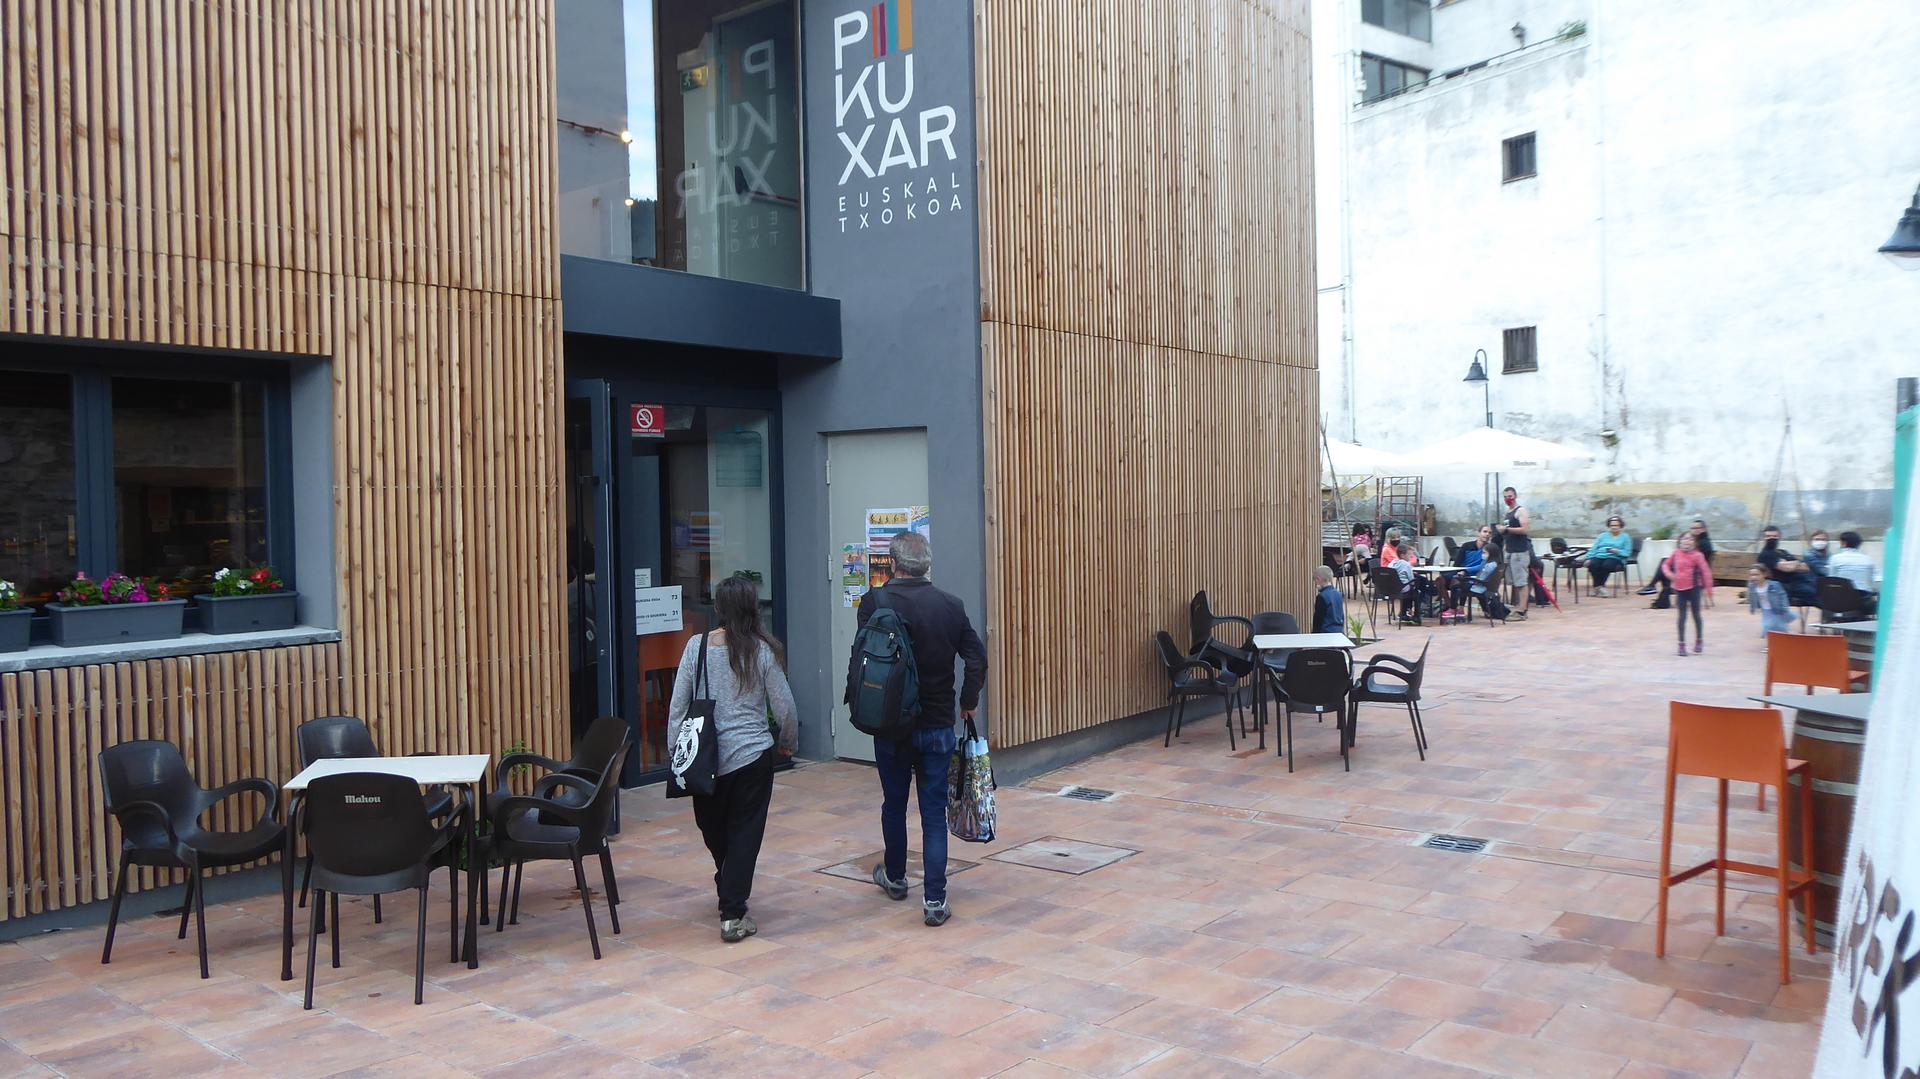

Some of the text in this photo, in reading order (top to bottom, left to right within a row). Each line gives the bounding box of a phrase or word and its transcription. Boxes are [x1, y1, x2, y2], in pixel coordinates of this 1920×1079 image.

[835, 53, 914, 128] KU
[836, 105, 957, 186] XAR
[839, 172, 960, 212] EUSKAL
[839, 194, 962, 233] TXOKOA
[344, 794, 381, 804] Mahou
